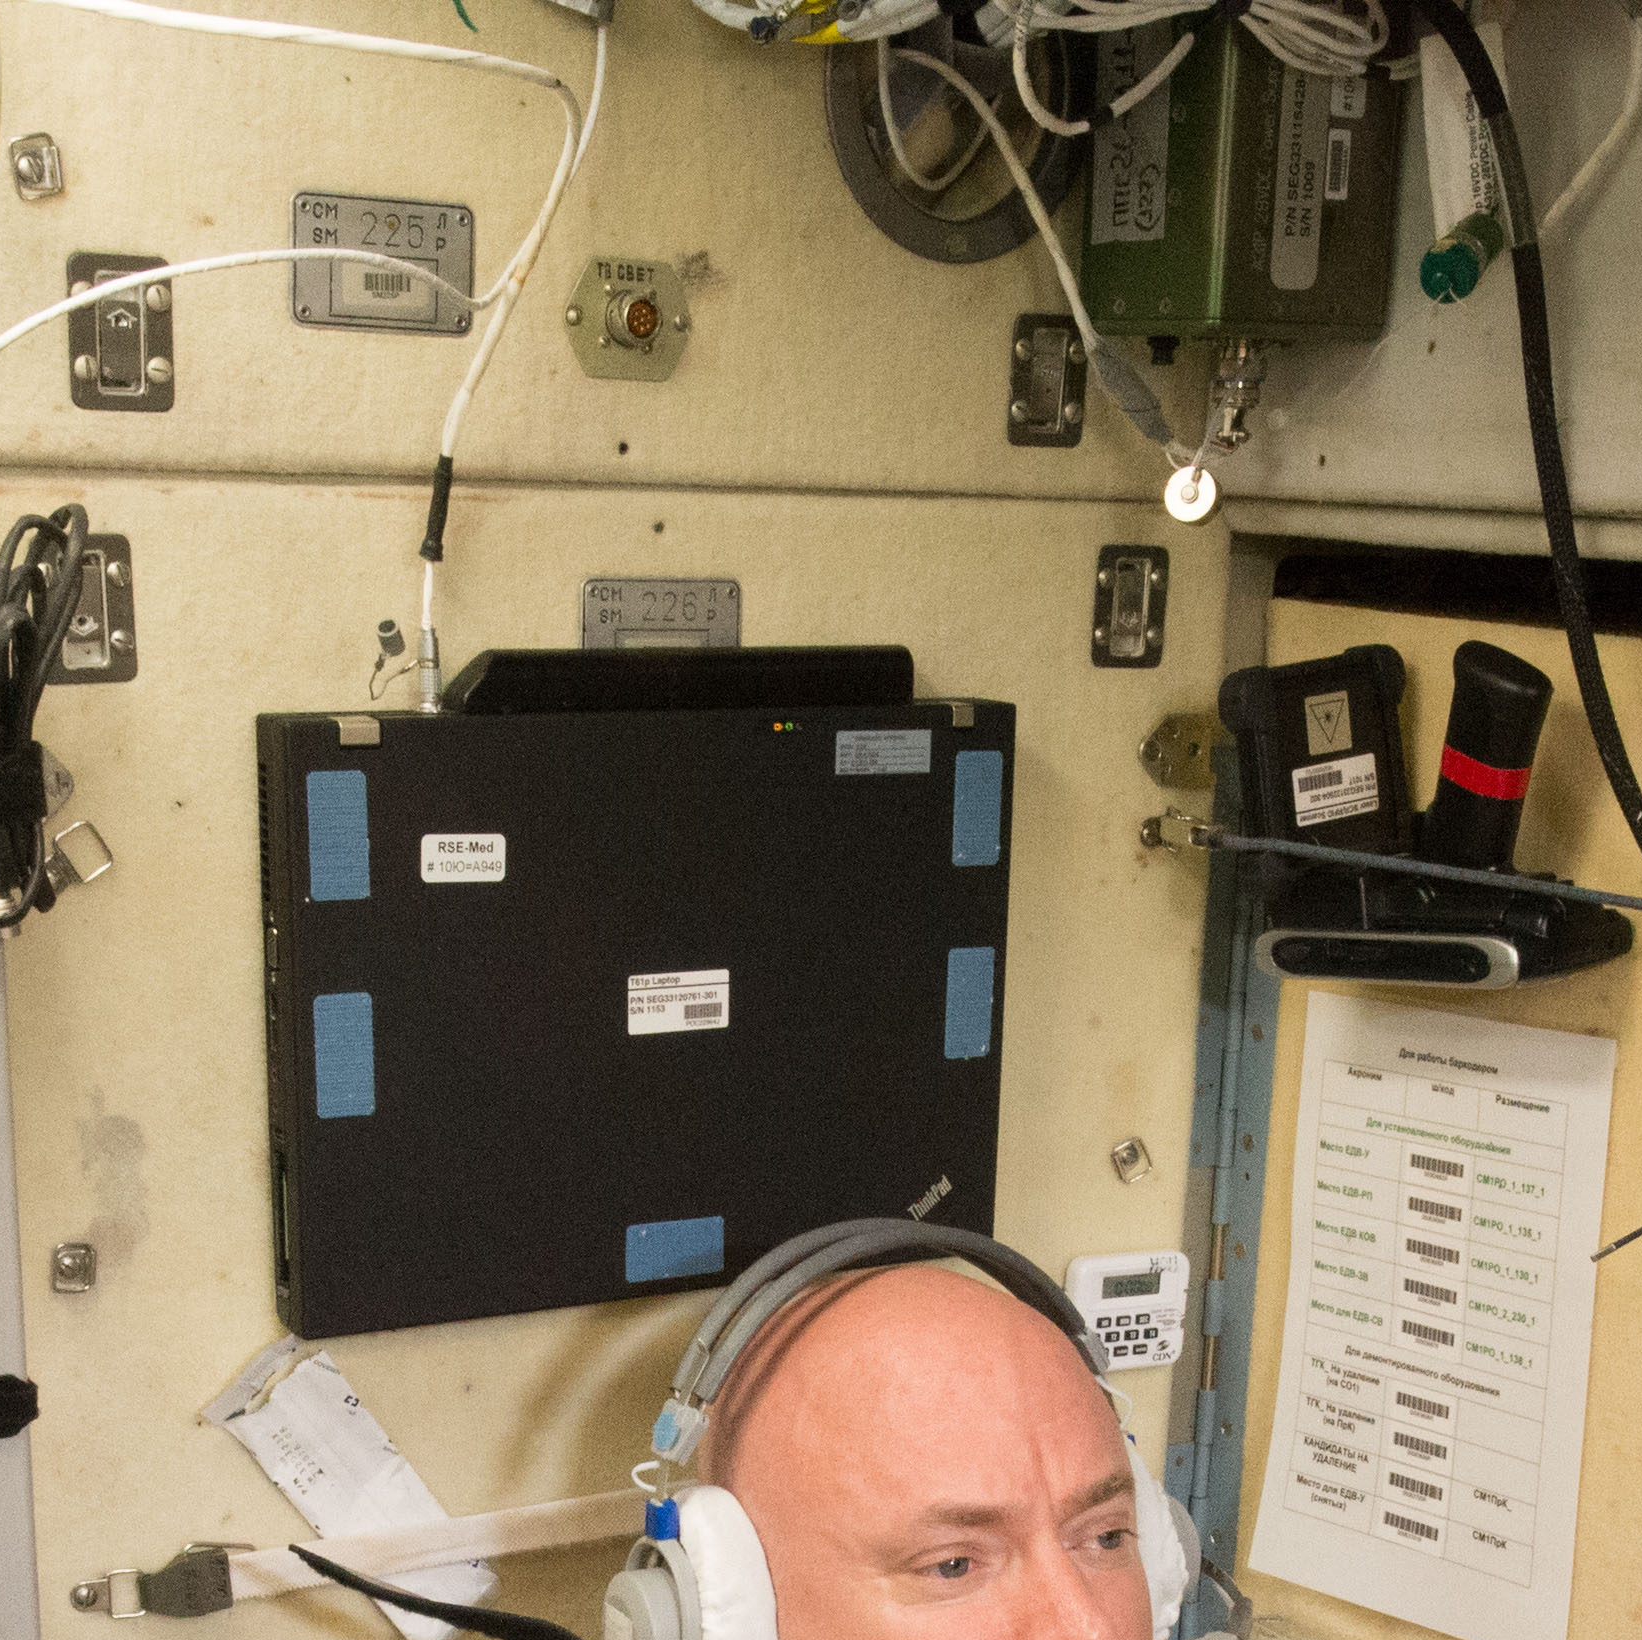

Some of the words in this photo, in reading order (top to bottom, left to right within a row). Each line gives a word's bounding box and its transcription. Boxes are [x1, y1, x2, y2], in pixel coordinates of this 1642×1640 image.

[312, 227, 338, 244] SM
[360, 211, 424, 248] 225
[599, 608, 622, 624] SM
[642, 591, 697, 622] 226
[438, 841, 494, 853] RSE-Med
[652, 976, 681, 985] Laptop
[907, 1174, 953, 1222] ThinkPad
[1304, 1436, 1356, 1459] КАНДИДАТЫ
[1312, 1451, 1357, 1474] УДАЛЕНИЕ
